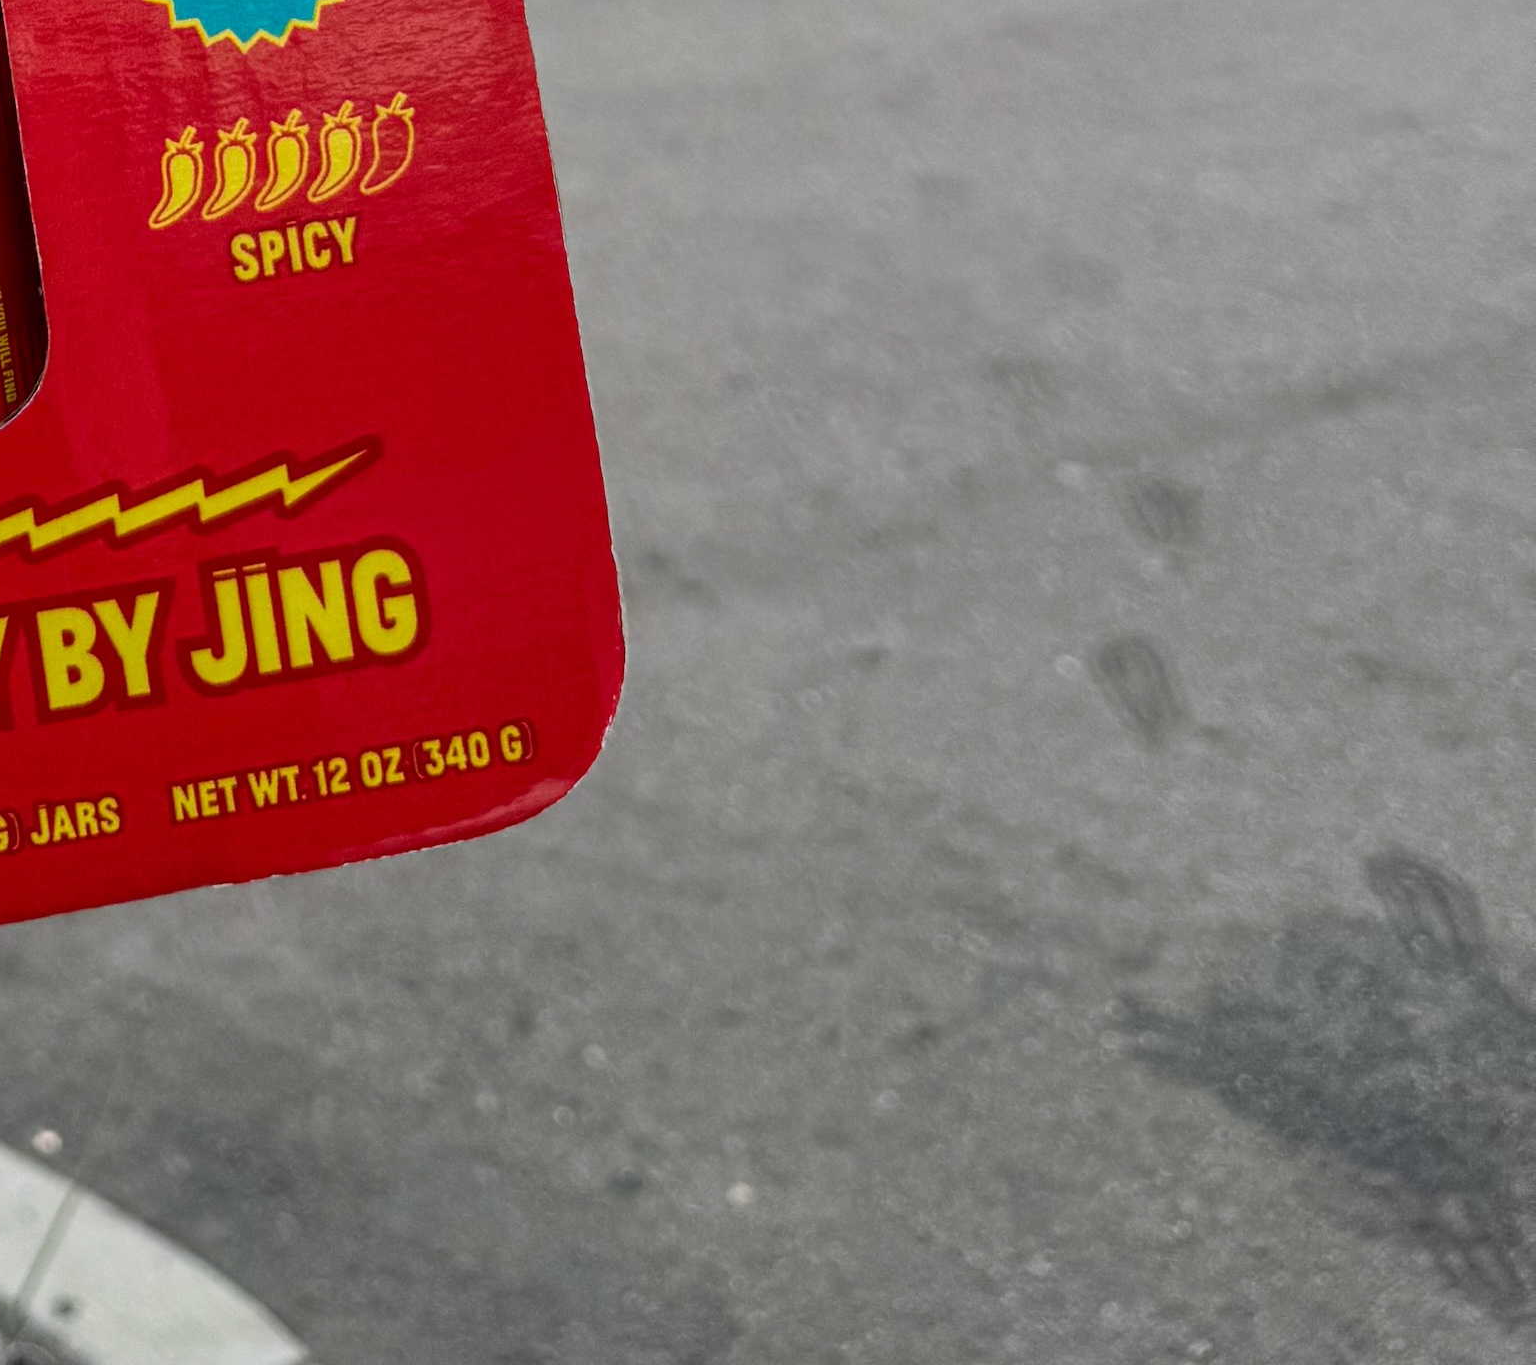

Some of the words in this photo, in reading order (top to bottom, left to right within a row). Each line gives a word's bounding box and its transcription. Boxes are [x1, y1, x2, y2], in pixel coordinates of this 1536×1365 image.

[3, 369, 17, 403] FIND
[36, 591, 160, 712] BY
[171, 776, 238, 823] NET
[312, 757, 351, 797] 12
[361, 747, 404, 788] OZ
[413, 731, 491, 779] (340
[499, 722, 534, 763] G)
